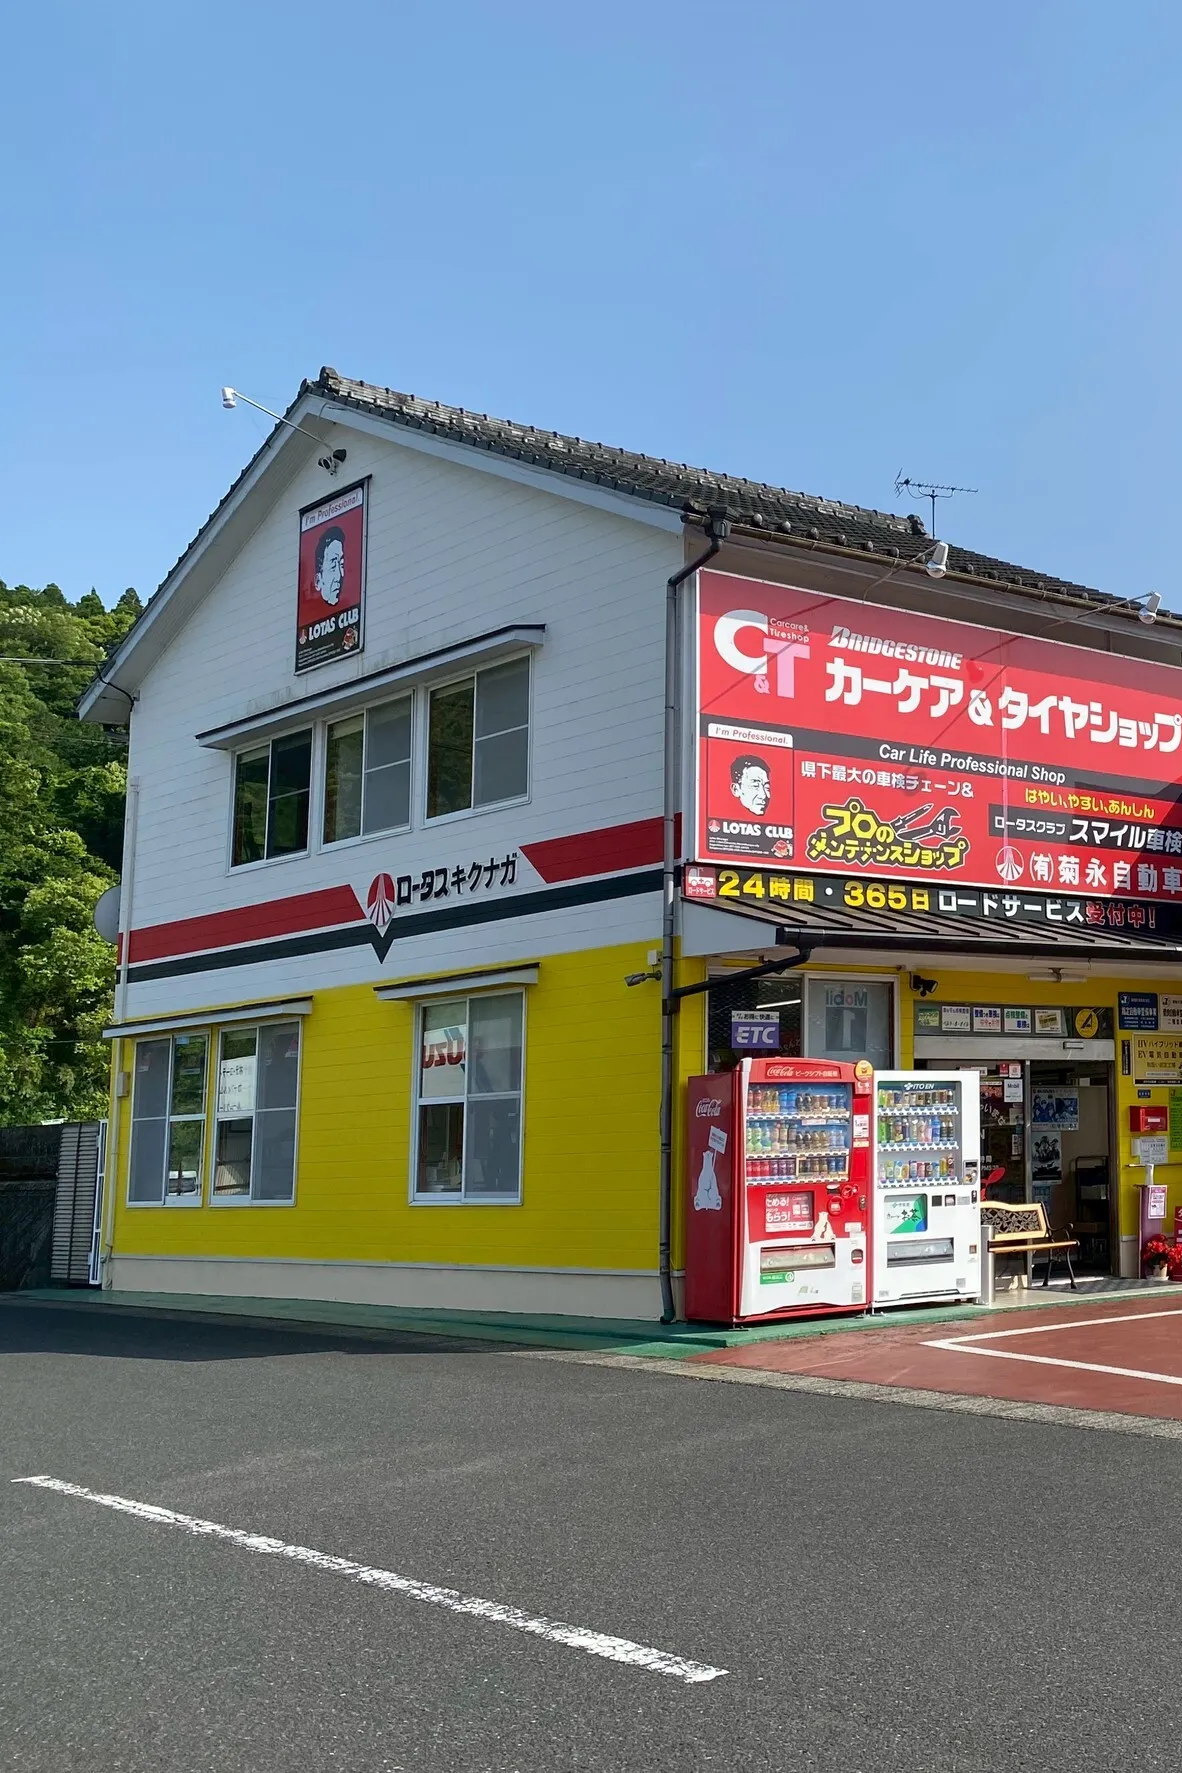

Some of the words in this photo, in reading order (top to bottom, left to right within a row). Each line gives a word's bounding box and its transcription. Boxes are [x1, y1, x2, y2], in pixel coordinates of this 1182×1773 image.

[308, 616, 336, 641] LOTAS
[337, 608, 359, 628] CLUB
[769, 627, 810, 644] Tireshop
[827, 625, 964, 670] BRIDGESTONE
[715, 726, 730, 736] I'm
[878, 743, 906, 761] Car
[909, 748, 937, 765] Life
[940, 752, 1028, 778] Professional
[1032, 766, 1066, 785] Shop
[723, 821, 762, 836] LOTAS
[765, 826, 793, 839] CLUB
[825, 802, 895, 843] プロの
[994, 816, 1066, 835] ロータスクラブ
[1069, 819, 1182, 853] スマイル車検
[397, 852, 518, 906] ロータスキクナガ
[736, 1026, 776, 1044] ETC
